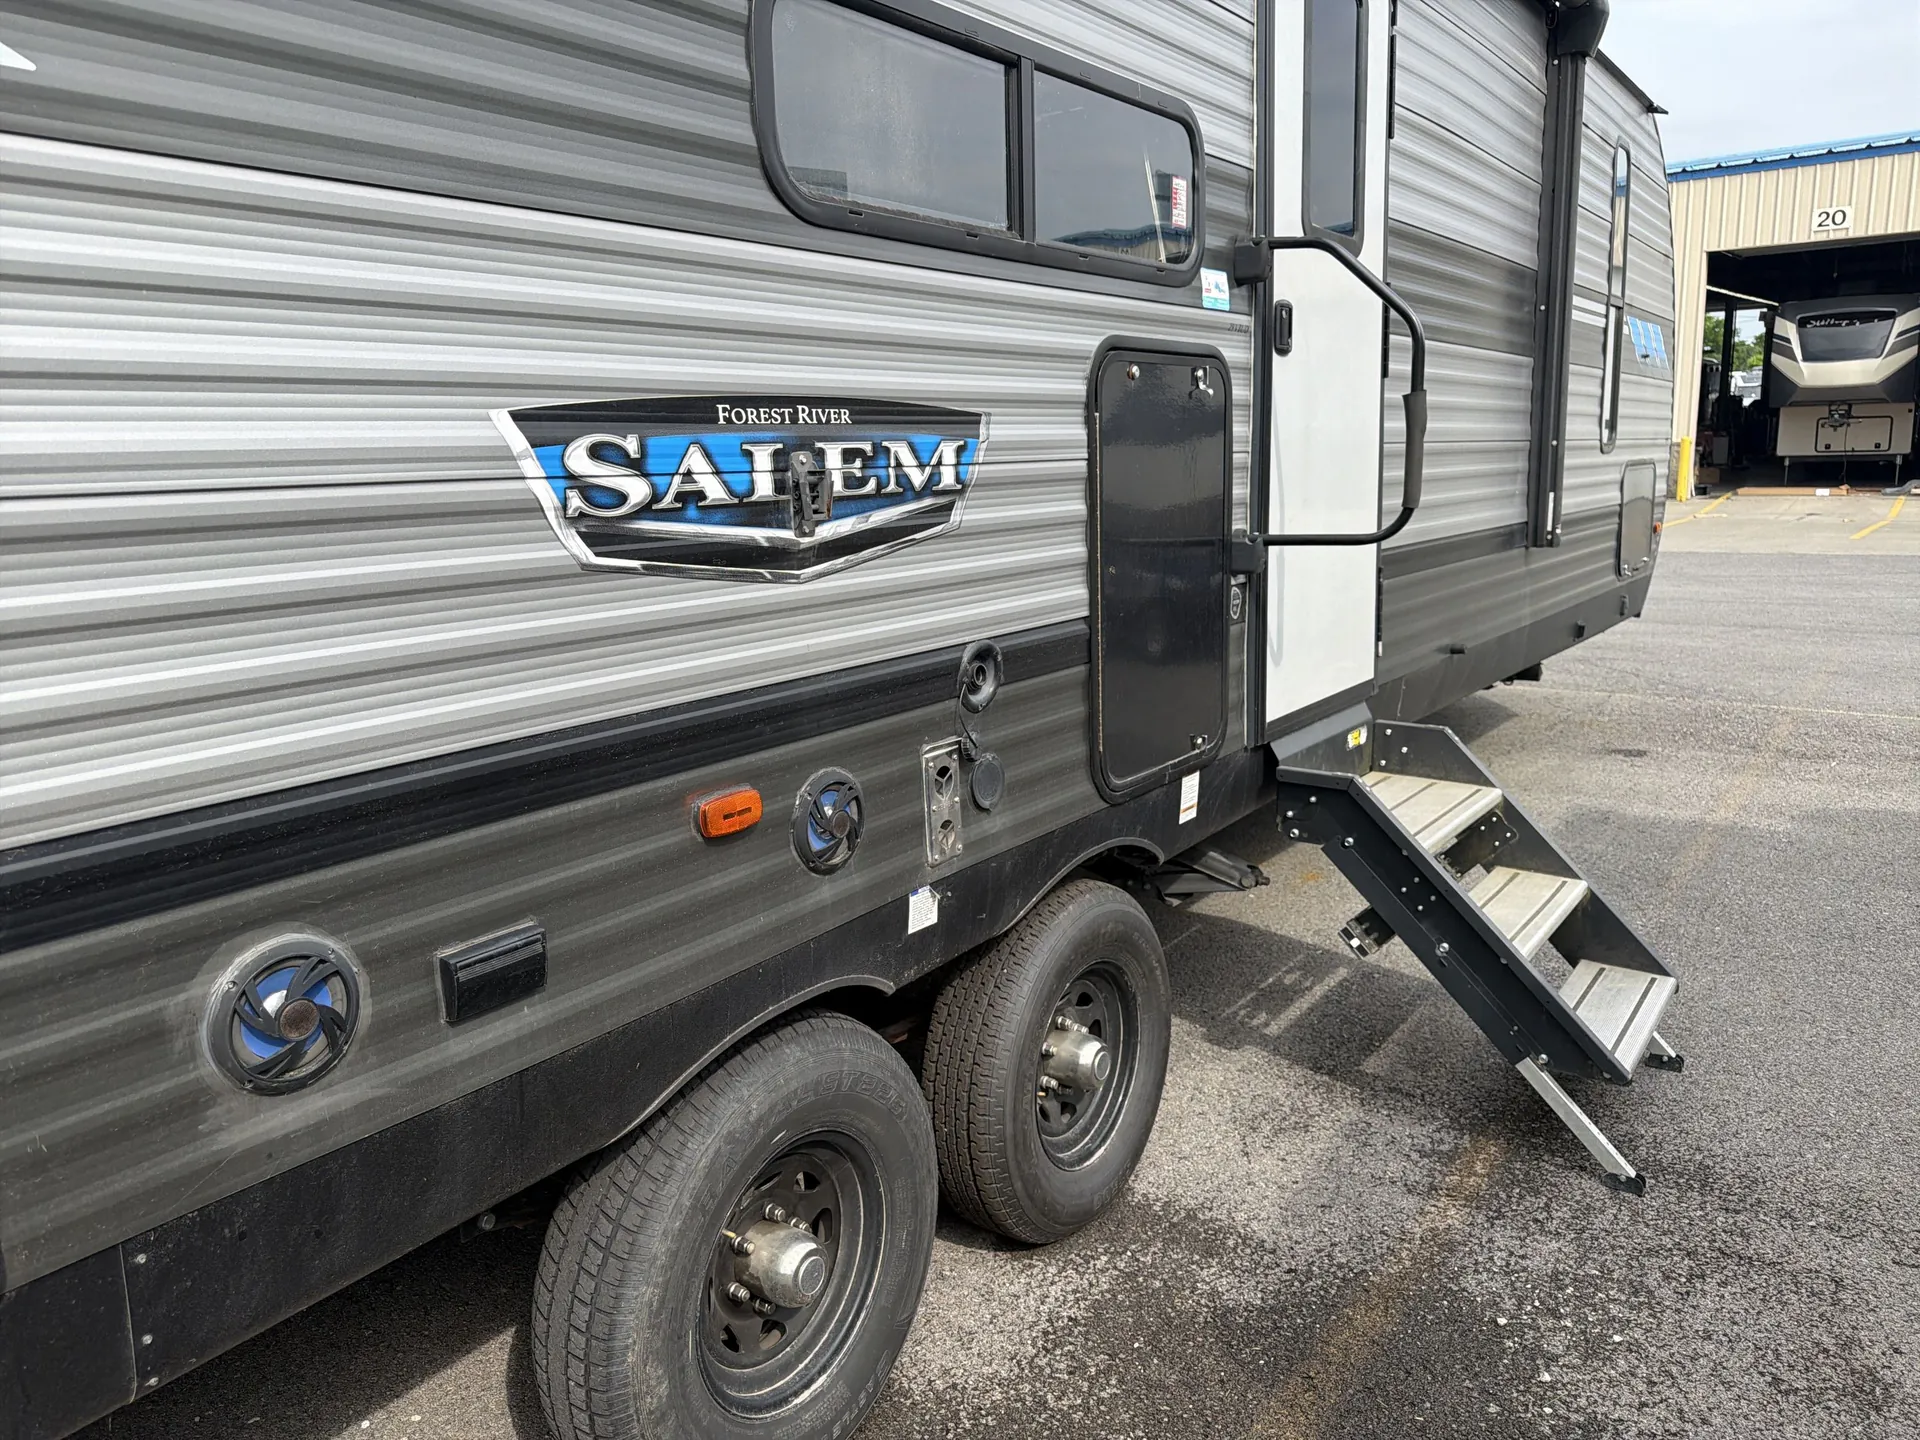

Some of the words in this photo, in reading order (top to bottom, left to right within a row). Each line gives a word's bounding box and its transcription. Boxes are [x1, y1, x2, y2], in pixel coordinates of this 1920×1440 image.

[1817, 209, 1847, 227] 20
[716, 404, 793, 425] FOREST
[796, 405, 853, 425] RIVER
[563, 433, 966, 519] SALEM
